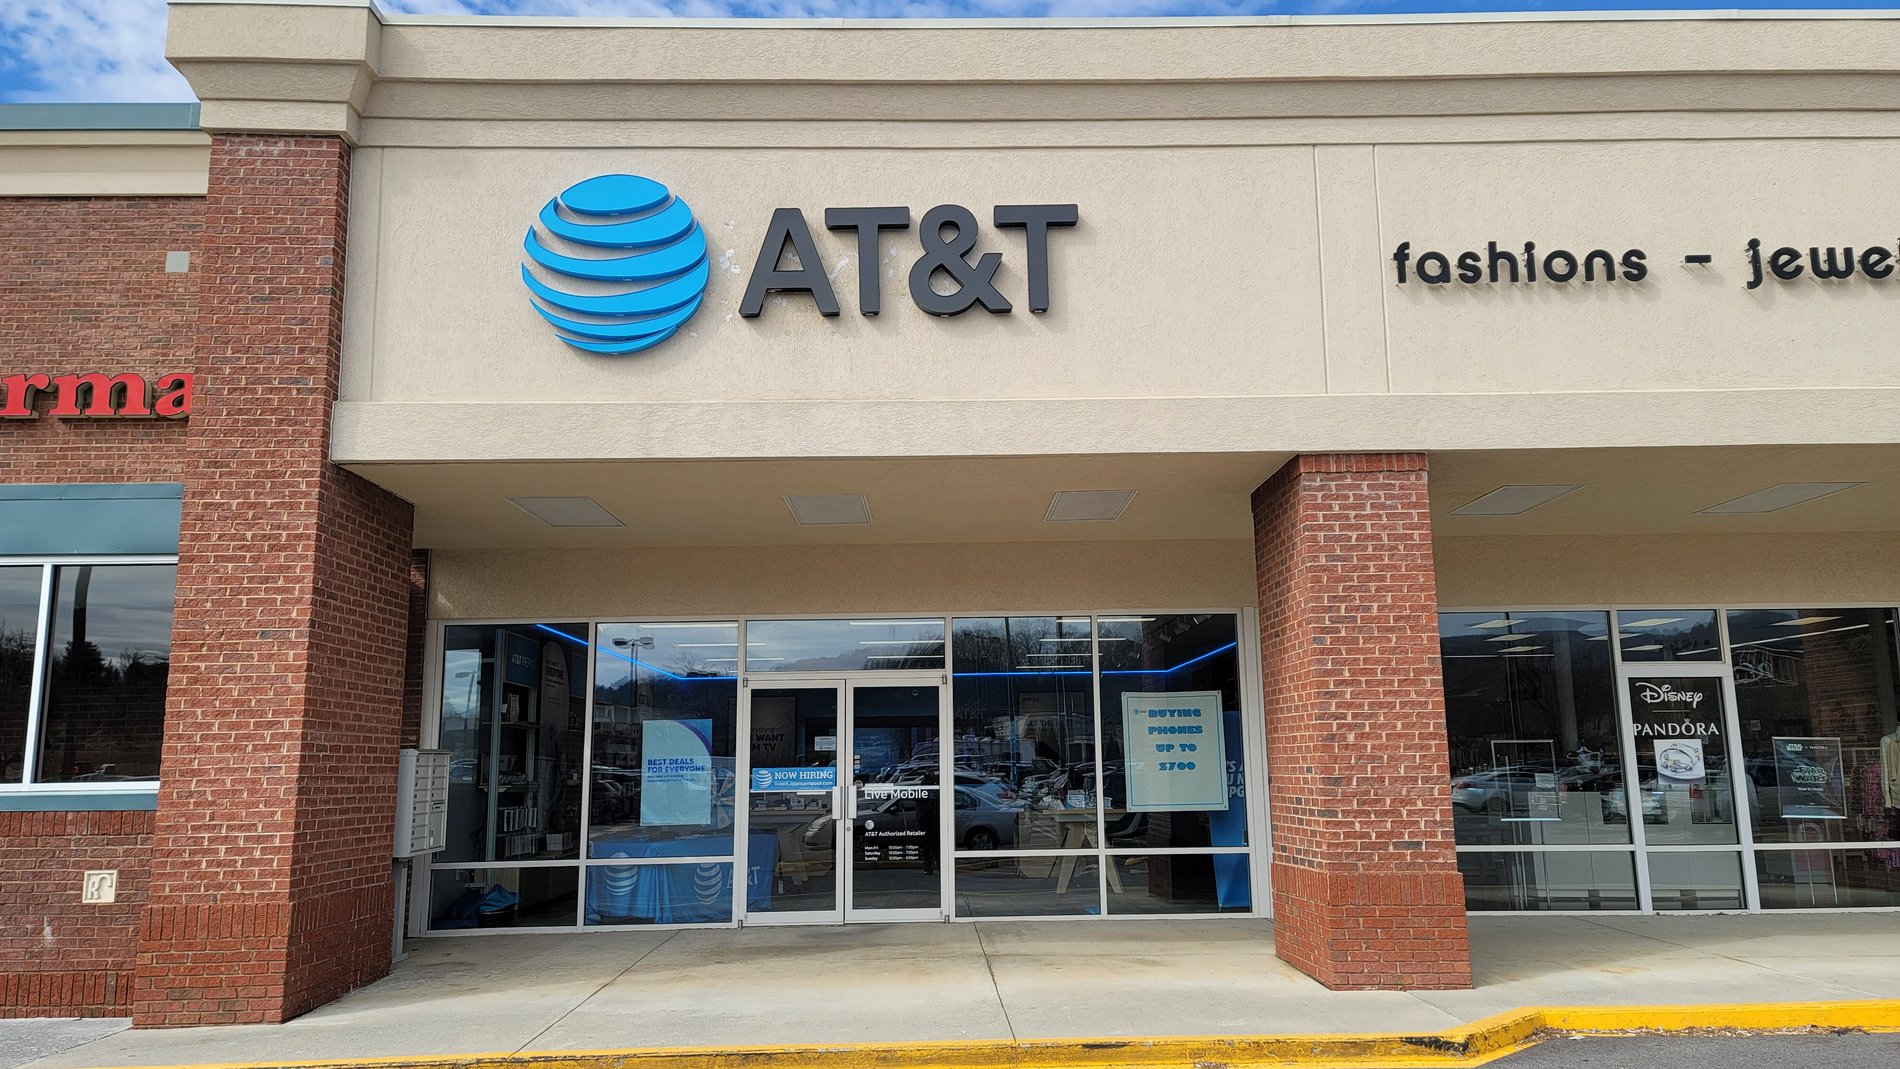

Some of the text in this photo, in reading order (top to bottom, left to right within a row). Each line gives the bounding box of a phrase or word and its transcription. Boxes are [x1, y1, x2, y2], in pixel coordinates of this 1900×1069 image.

[739, 204, 1079, 317] AT&T
[1394, 241, 1648, 284] fashions
[1747, 237, 1900, 289] jewe
[0, 373, 194, 419] rma
[1148, 708, 1201, 718] BUYING
[1148, 725, 1204, 735] PHONES
[1633, 720, 1720, 736] PANDORA
[756, 734, 784, 742] WANT
[763, 743, 776, 751] TV
[1155, 743, 1198, 753] UP TO
[669, 758, 694, 766] DEALS
[1159, 761, 1197, 771] $700
[647, 765, 705, 774] FOR EVERYONE
[799, 770, 833, 779] HIRING
[1792, 765, 1827, 776] STAR
[1791, 773, 1828, 784] WARS
[864, 789, 928, 799] Live Mobile
